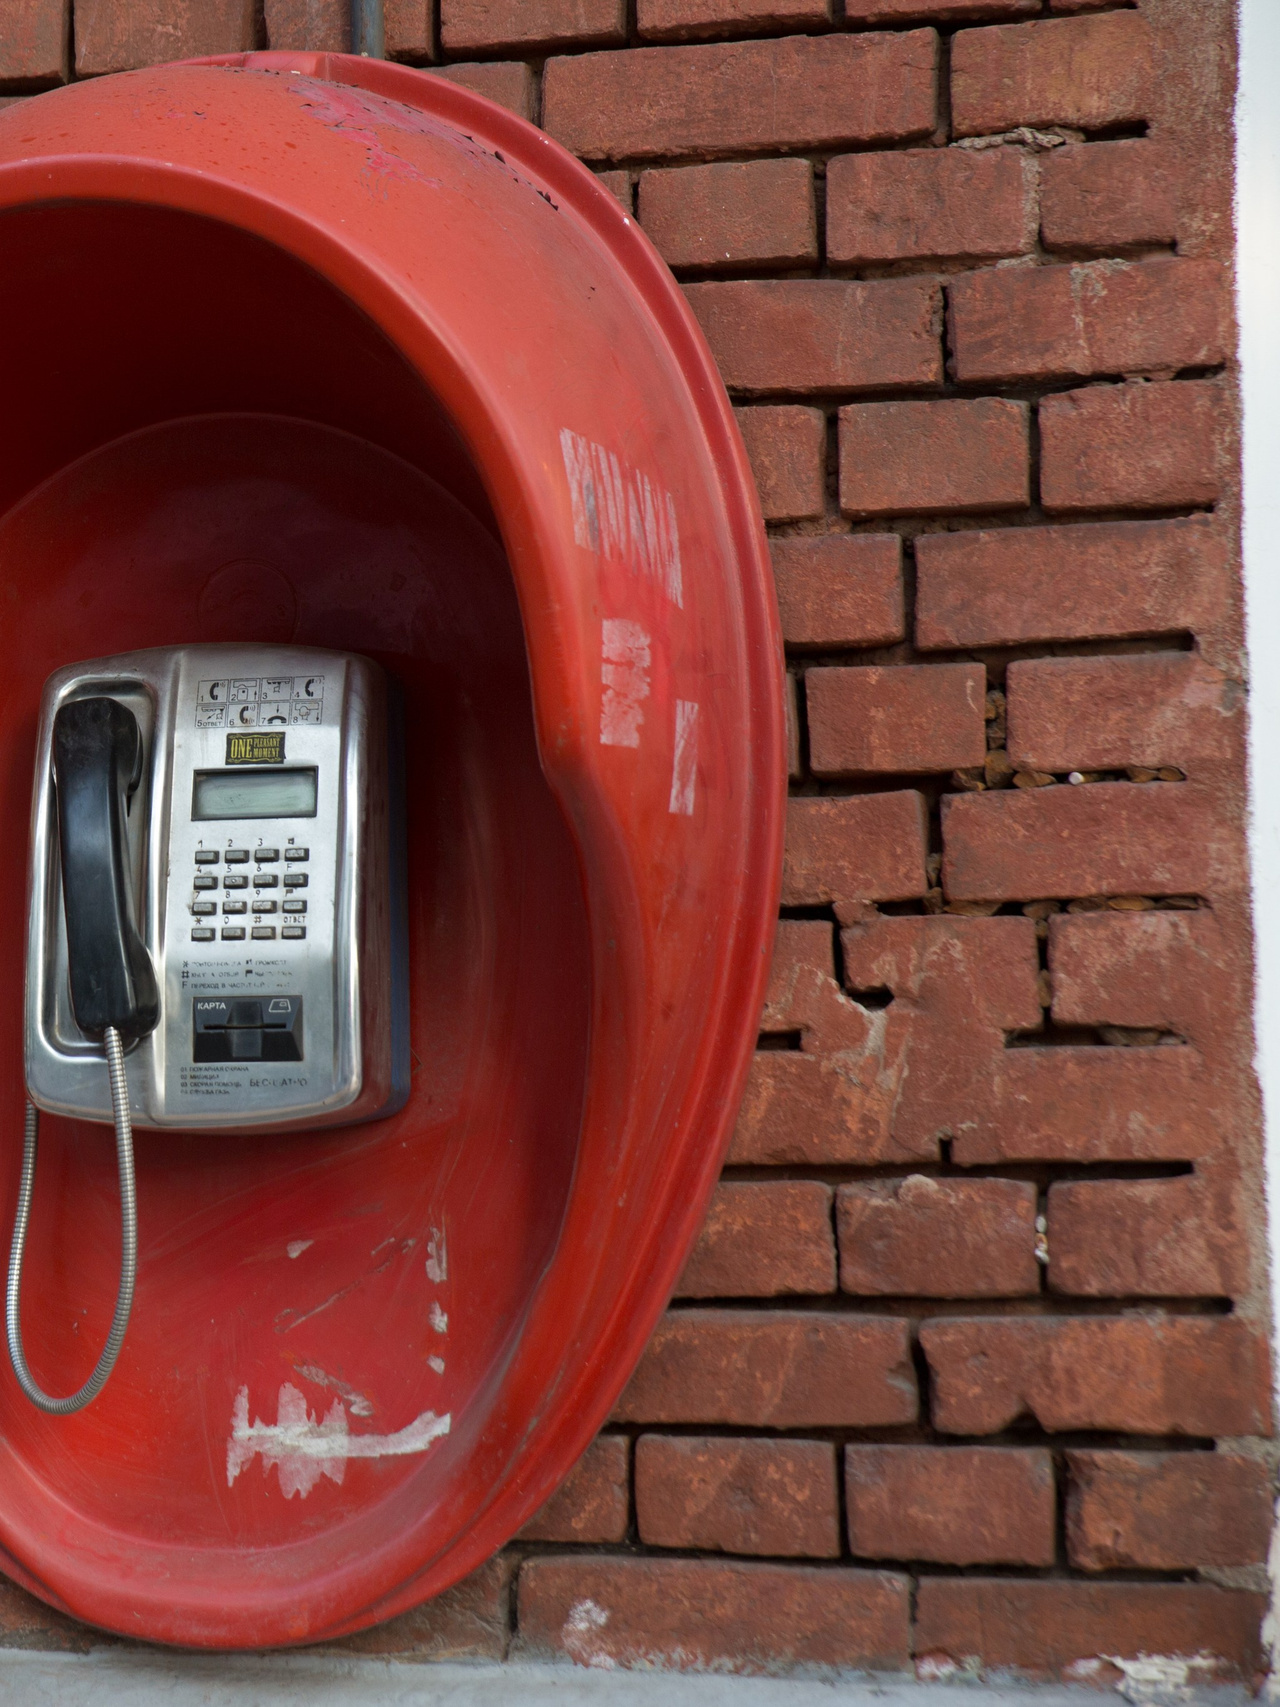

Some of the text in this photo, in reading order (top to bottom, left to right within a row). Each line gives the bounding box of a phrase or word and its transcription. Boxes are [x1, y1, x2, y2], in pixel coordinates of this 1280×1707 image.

[253, 737, 280, 747] PLEASANT
[230, 738, 253, 759] ONE
[253, 747, 280, 758] MOMENT
[283, 915, 306, 924] ОТВЕТ
[197, 1001, 226, 1010] КАРТА
